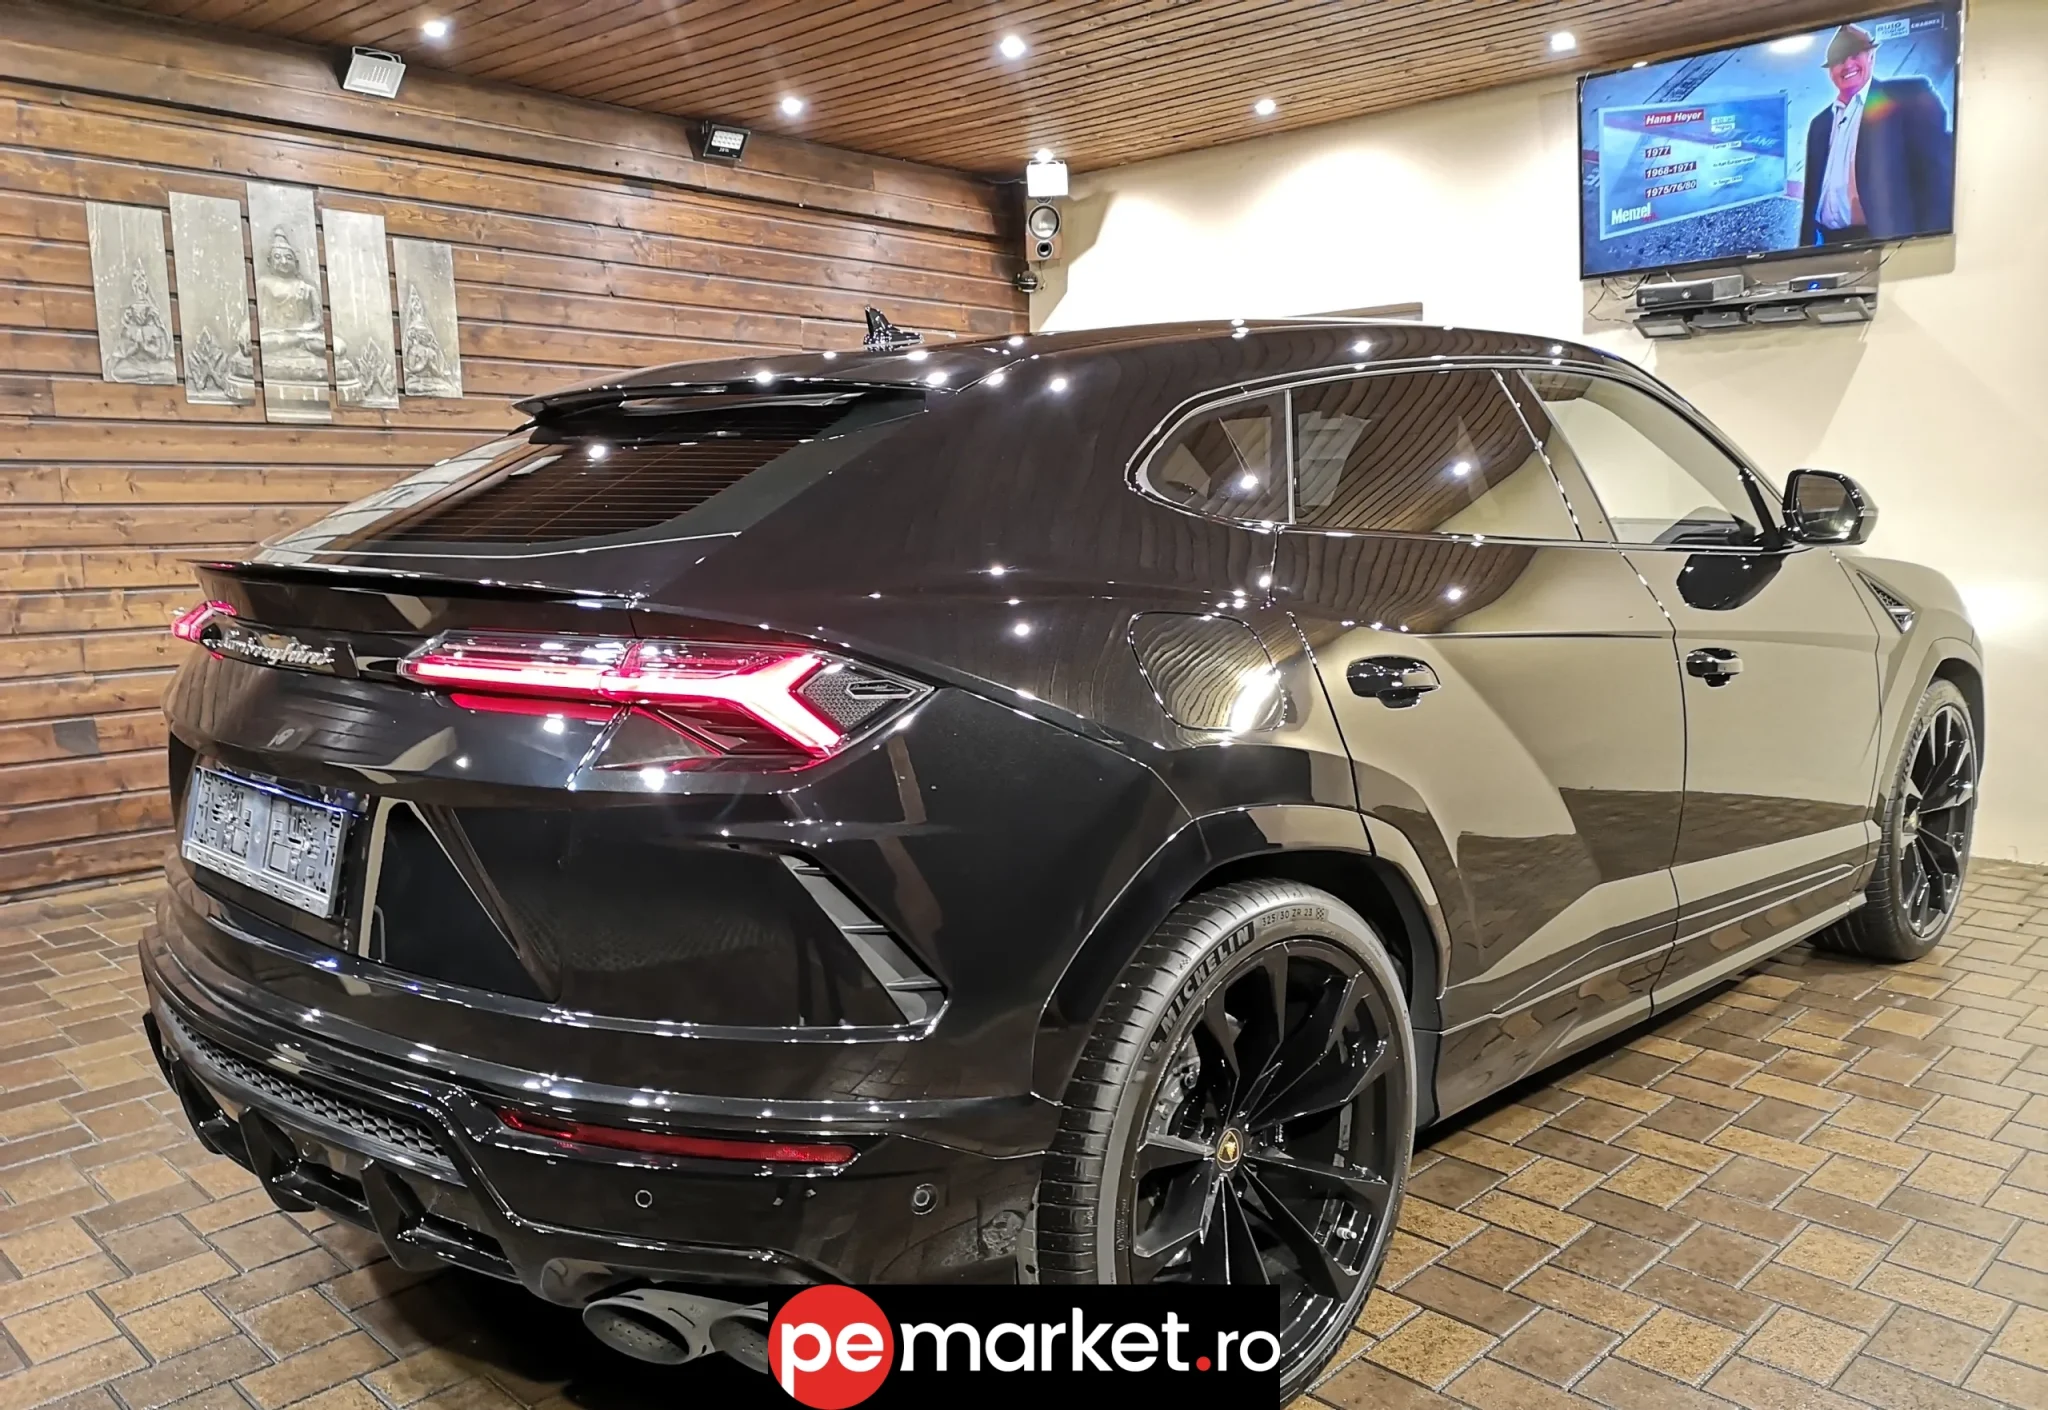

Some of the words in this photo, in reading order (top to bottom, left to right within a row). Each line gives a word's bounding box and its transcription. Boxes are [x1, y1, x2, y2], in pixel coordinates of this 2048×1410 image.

[1646, 114, 1672, 126] Hans
[1647, 146, 1671, 158] 1977
[1646, 162, 1694, 178] 1968-1971
[1646, 180, 1697, 198] 1975/76/80
[1611, 202, 1651, 226] Menzel
[1304, 908, 1313, 917] 23
[1161, 923, 1251, 1035] MICHELIN
